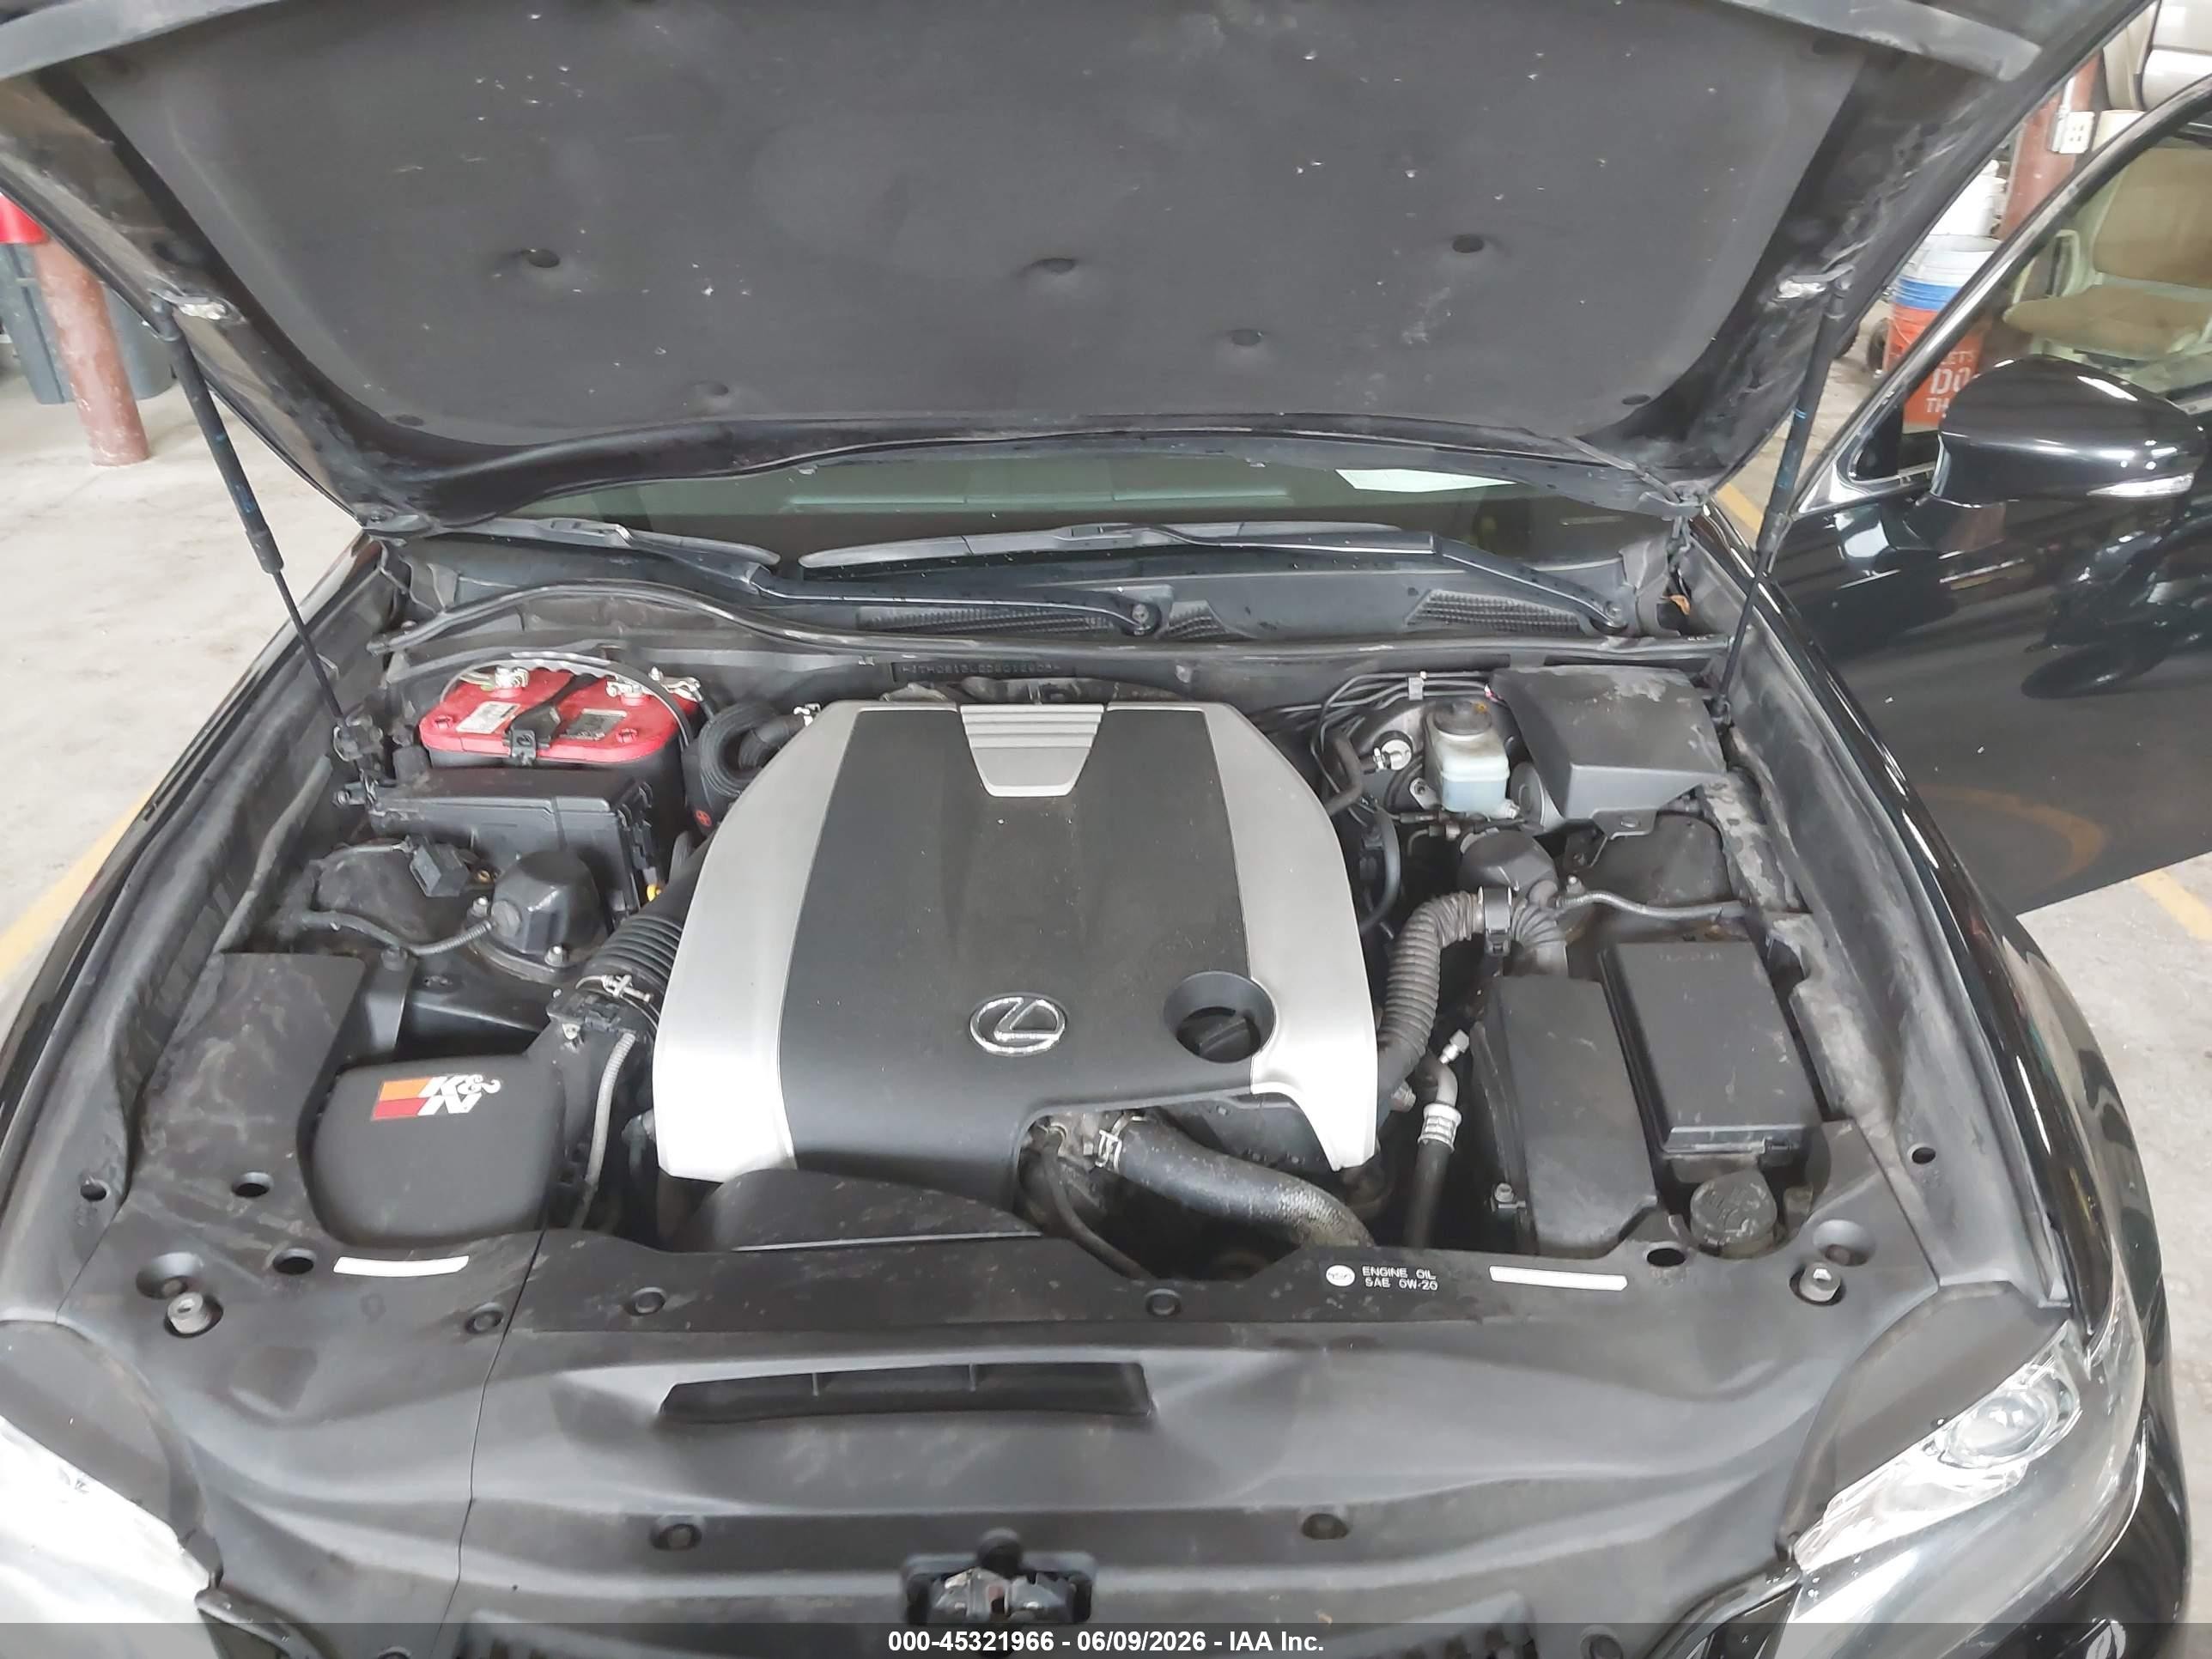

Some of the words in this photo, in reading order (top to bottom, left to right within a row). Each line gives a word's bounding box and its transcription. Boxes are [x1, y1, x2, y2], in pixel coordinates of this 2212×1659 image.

[1362, 1266, 1408, 1279] ENGINE
[1416, 1268, 1437, 1280] OIL
[1365, 1277, 1391, 1288] SAE
[1399, 1279, 1438, 1291] 0W-20
